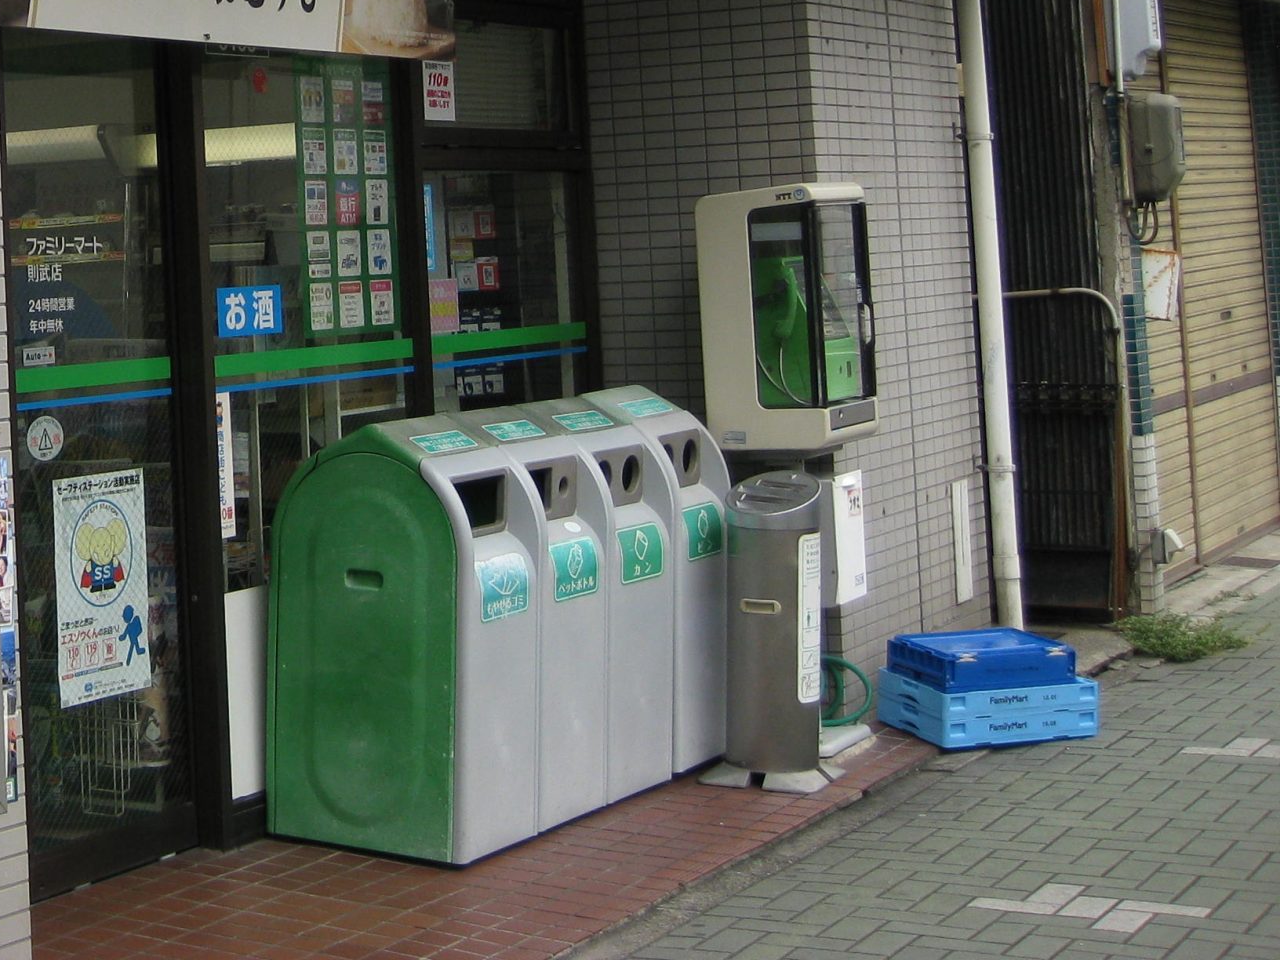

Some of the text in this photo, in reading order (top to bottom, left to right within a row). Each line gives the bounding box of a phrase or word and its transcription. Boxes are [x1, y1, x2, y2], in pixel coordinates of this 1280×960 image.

[775, 192, 792, 201] NTT
[26, 235, 103, 256] ファミリーマート
[27, 263, 63, 283] 則武店
[28, 297, 75, 313] 24時間営業
[225, 289, 275, 331] お酒
[29, 318, 64, 334] 年中無休
[25, 352, 41, 361] Auto
[94, 565, 111, 581] SS
[634, 562, 652, 577] カン
[559, 576, 595, 593] ペットボトル
[989, 694, 1029, 706] FamilyMart
[988, 721, 1028, 733] FamilyMart
